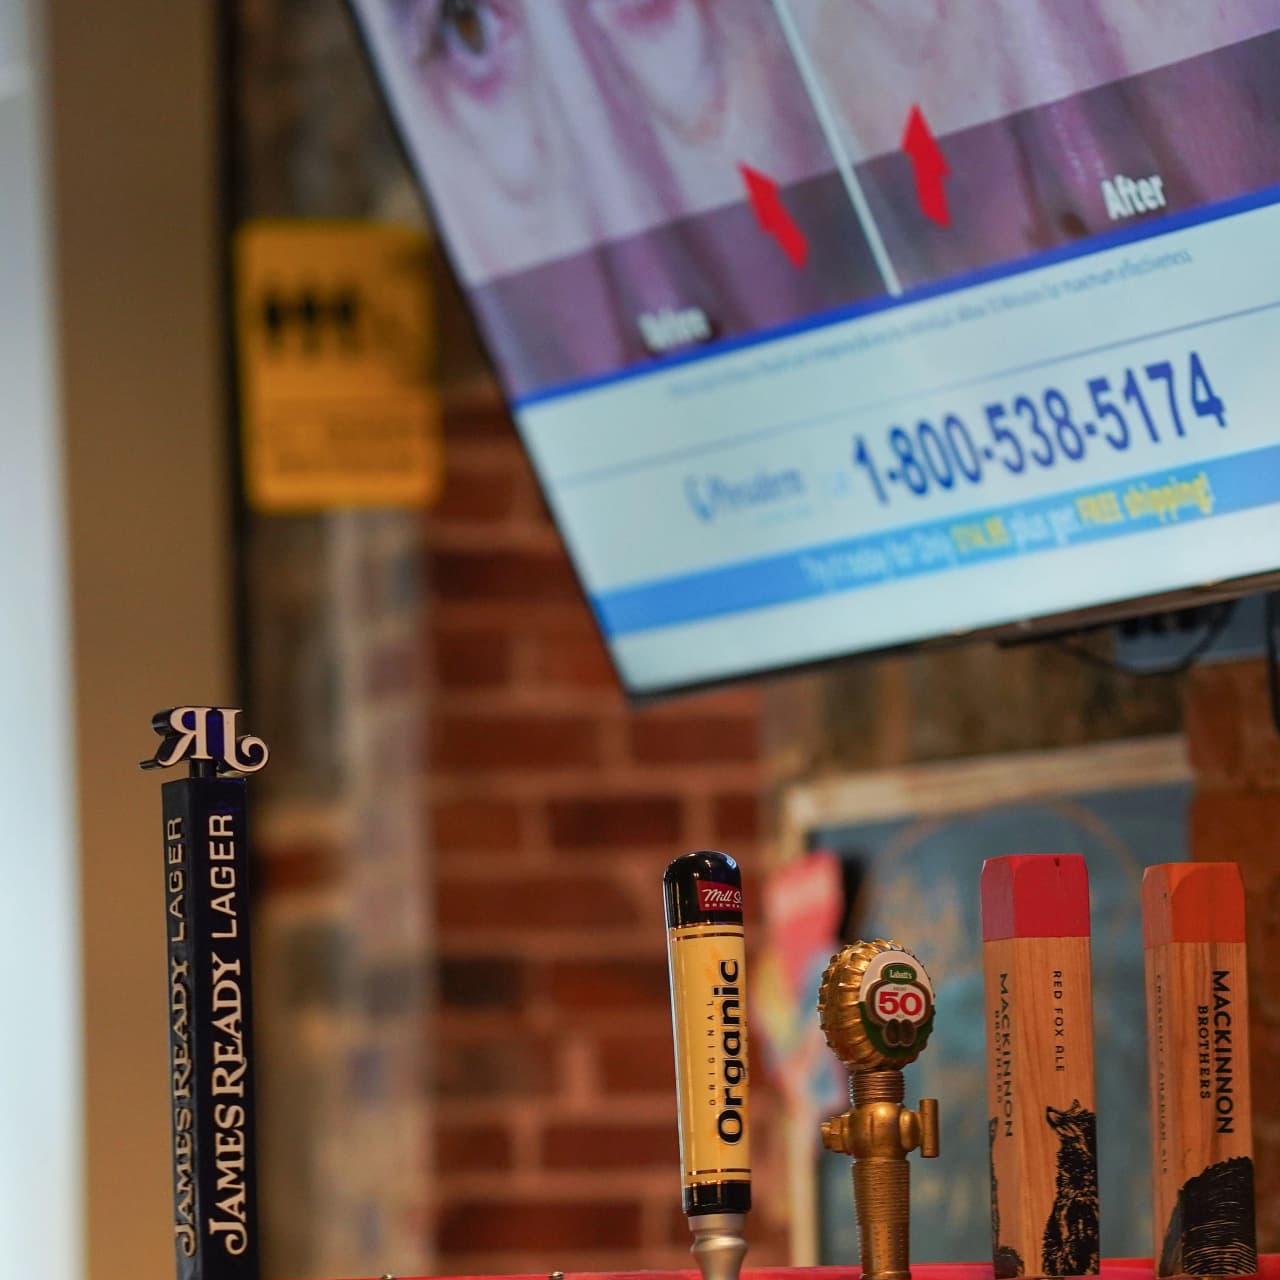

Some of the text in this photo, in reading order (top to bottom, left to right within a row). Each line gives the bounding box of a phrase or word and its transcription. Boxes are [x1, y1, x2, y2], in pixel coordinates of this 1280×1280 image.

[1101, 174, 1167, 221] After
[851, 351, 1228, 506] 1-800-538-5174
[701, 888, 732, 903] Mill
[166, 816, 198, 1258] JAMES READY LAGER
[208, 814, 248, 1256] JAMES READY LAGER
[707, 1000, 717, 1106] ORIGINAL
[716, 958, 746, 1145] Organic
[878, 991, 923, 1016] 50
[1000, 973, 1013, 1137] MACKINNON
[1053, 970, 1065, 1072] RED FOX ALE
[1198, 1005, 1211, 1099] BROTHERS
[1212, 970, 1235, 1134] MACKINNON
